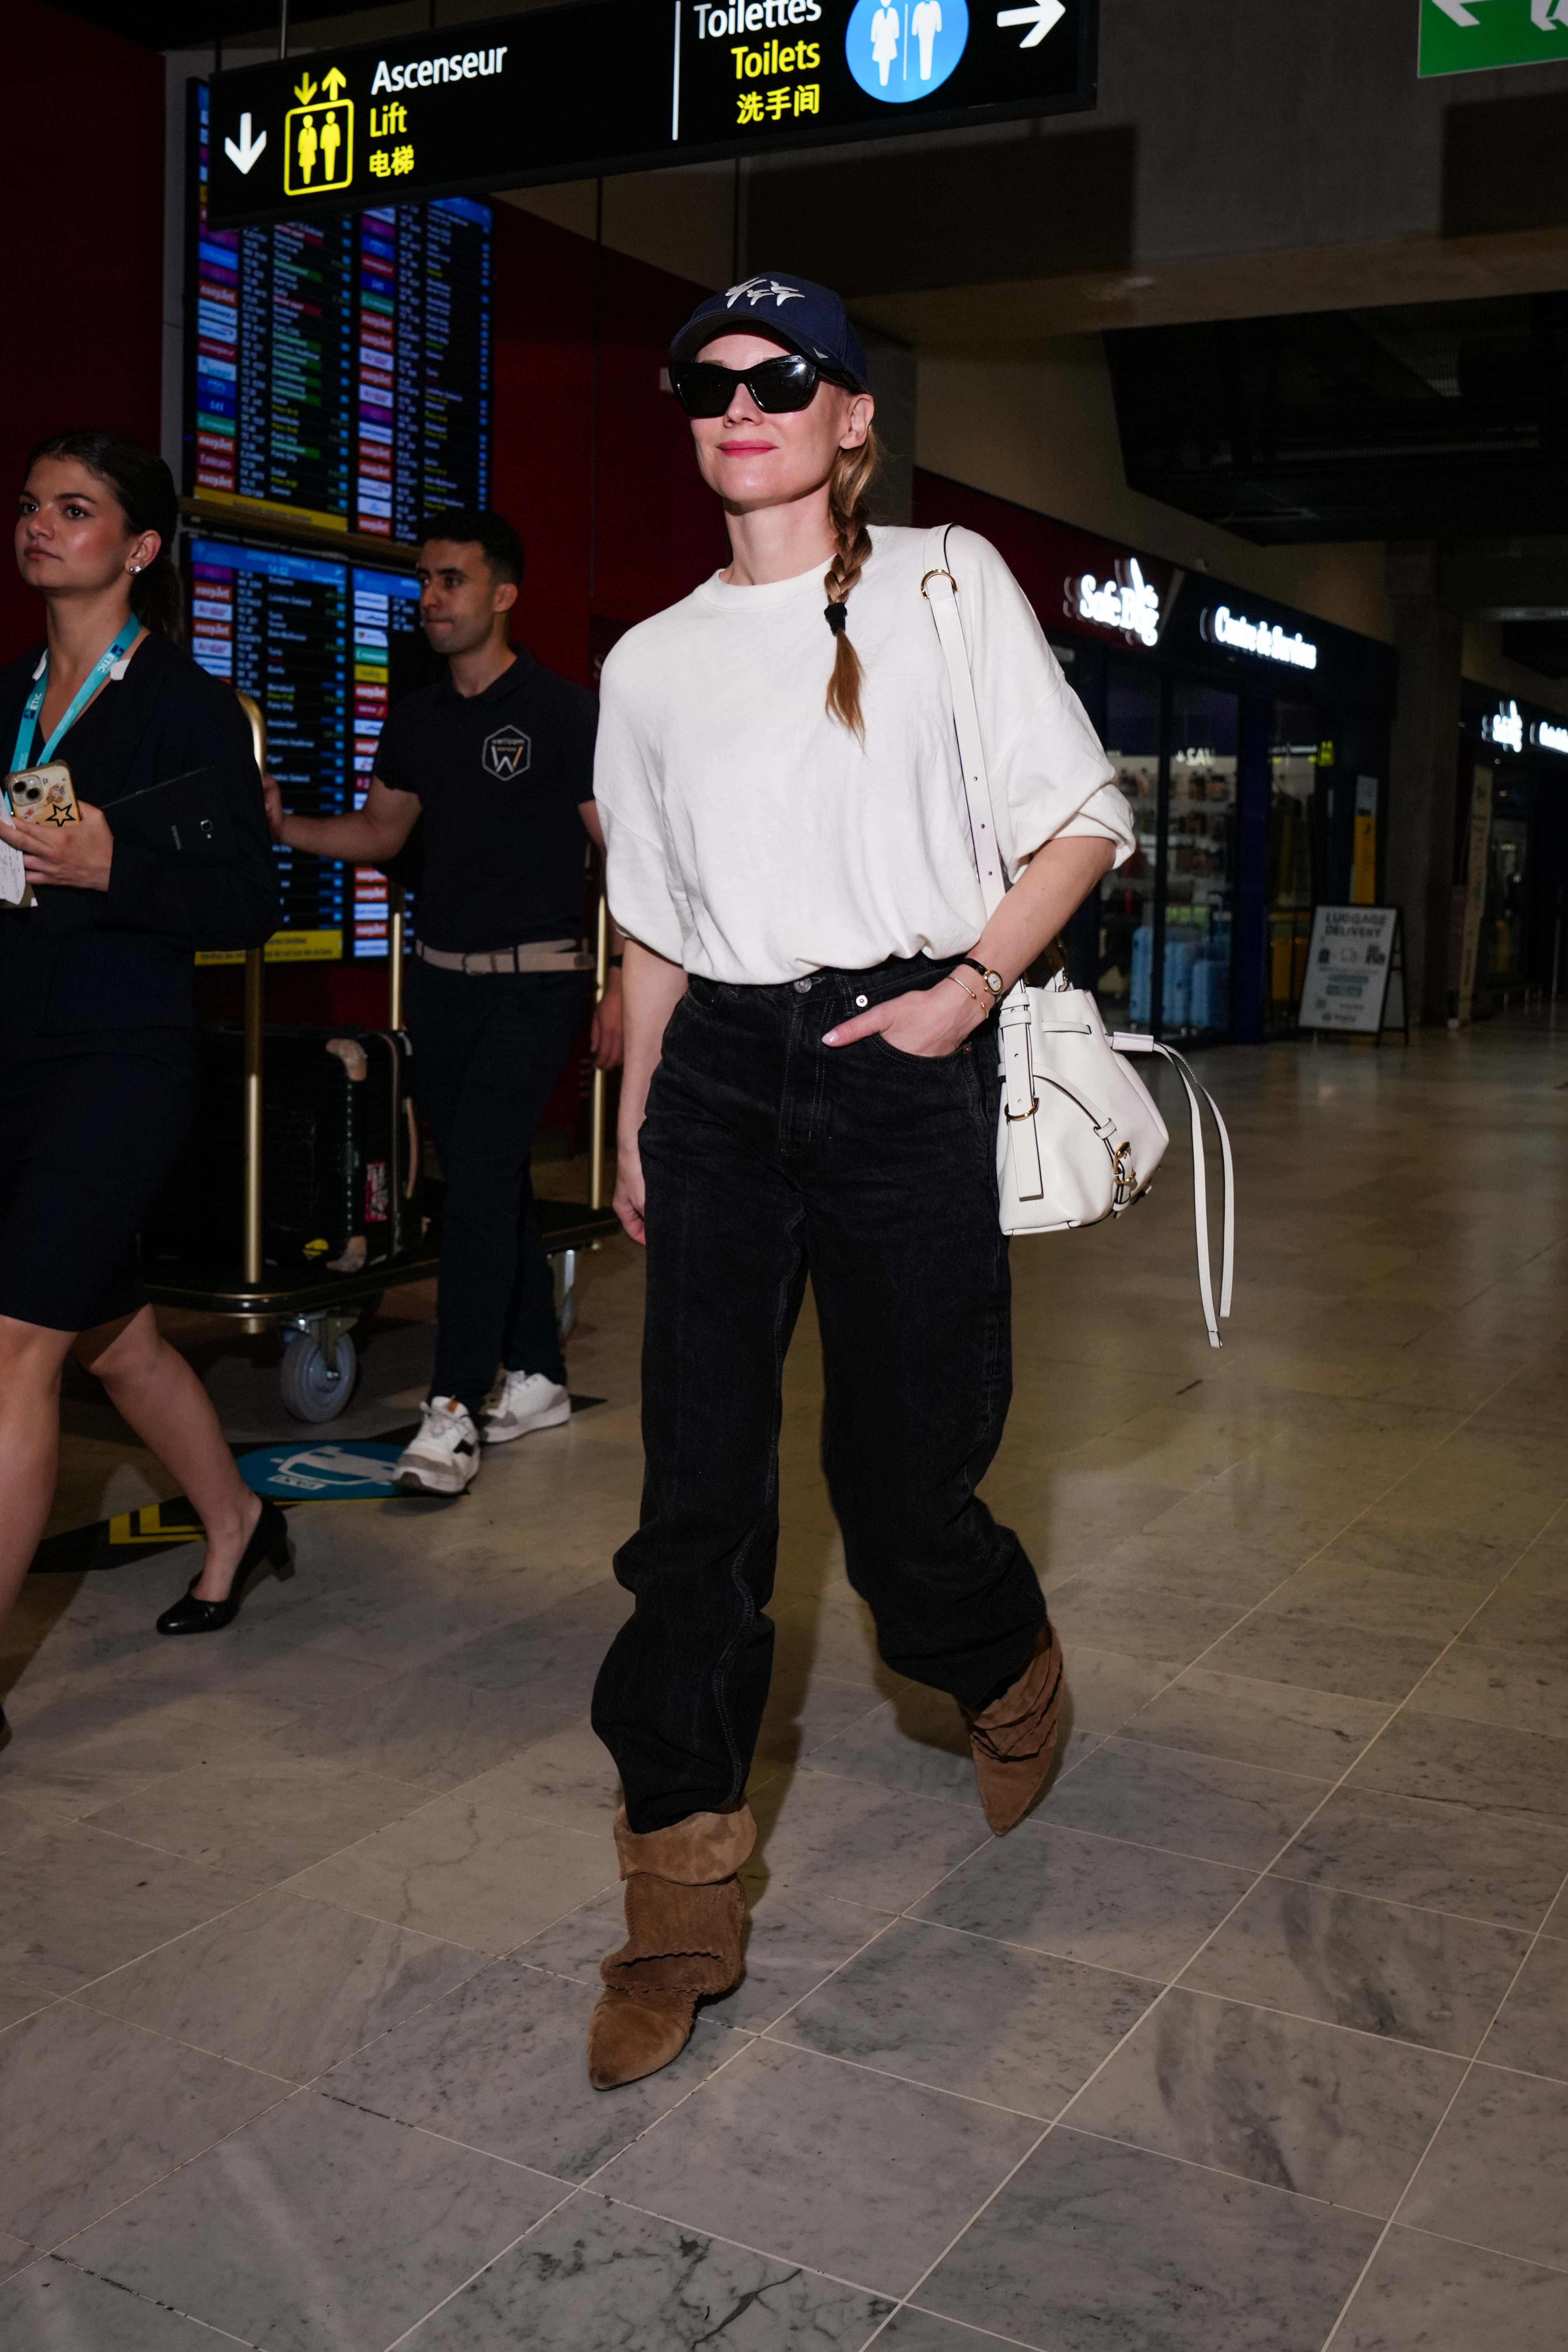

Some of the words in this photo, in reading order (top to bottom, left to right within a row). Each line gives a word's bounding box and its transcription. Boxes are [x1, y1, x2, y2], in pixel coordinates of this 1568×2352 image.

[693, 0, 821, 39] Toilettes
[371, 46, 508, 95] Ascenseur
[731, 39, 820, 79] Toilets
[370, 101, 407, 138] Lift
[736, 84, 820, 124] 洗手间
[369, 145, 414, 177] 电梯
[1080, 575, 1121, 626] Safe
[1119, 587, 1159, 646] Bag
